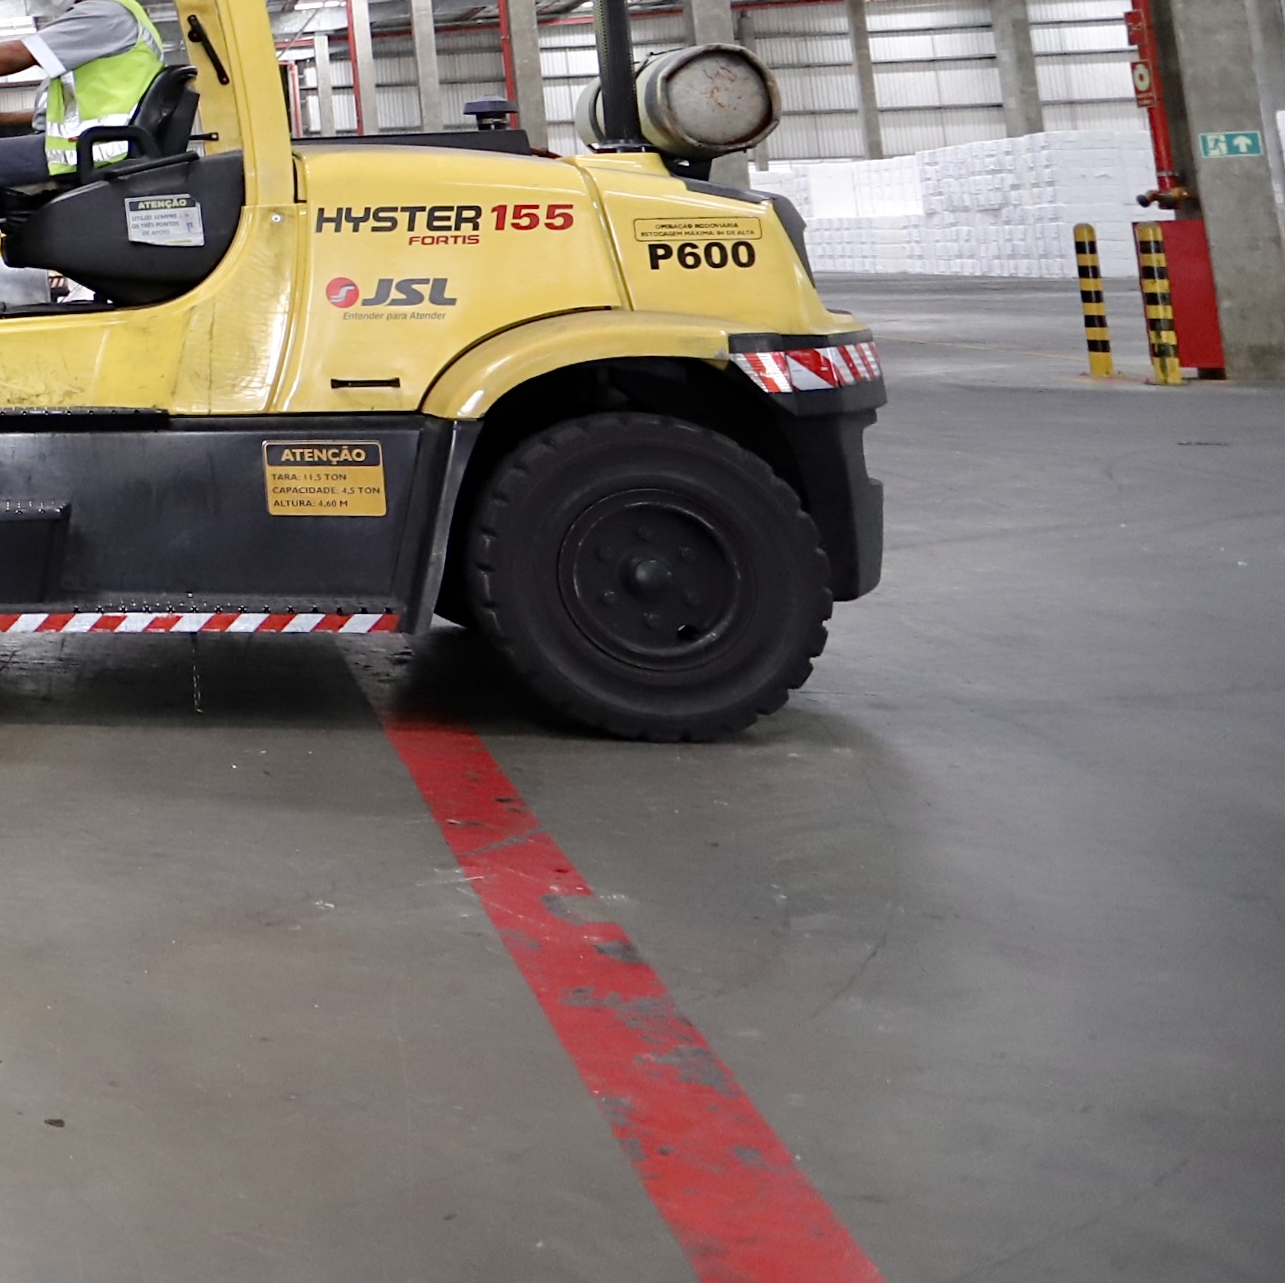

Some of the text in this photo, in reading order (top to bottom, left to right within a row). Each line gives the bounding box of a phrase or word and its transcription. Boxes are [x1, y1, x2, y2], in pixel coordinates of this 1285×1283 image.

[138, 198, 187, 210] ATENÇÃO
[315, 204, 574, 233] HYSTER 155
[408, 234, 480, 246] FORTIS
[648, 241, 756, 270] P600
[361, 278, 458, 307] JSL
[343, 311, 447, 321] Entender para Atender
[281, 446, 366, 465] ATENÇÃO
[272, 473, 300, 481] TARA:
[325, 473, 347, 481] TON
[272, 486, 340, 494] CAPACIDADE:
[358, 486, 381, 494] TON
[273, 499, 316, 507] ALTURA:
[339, 499, 348, 507] M
